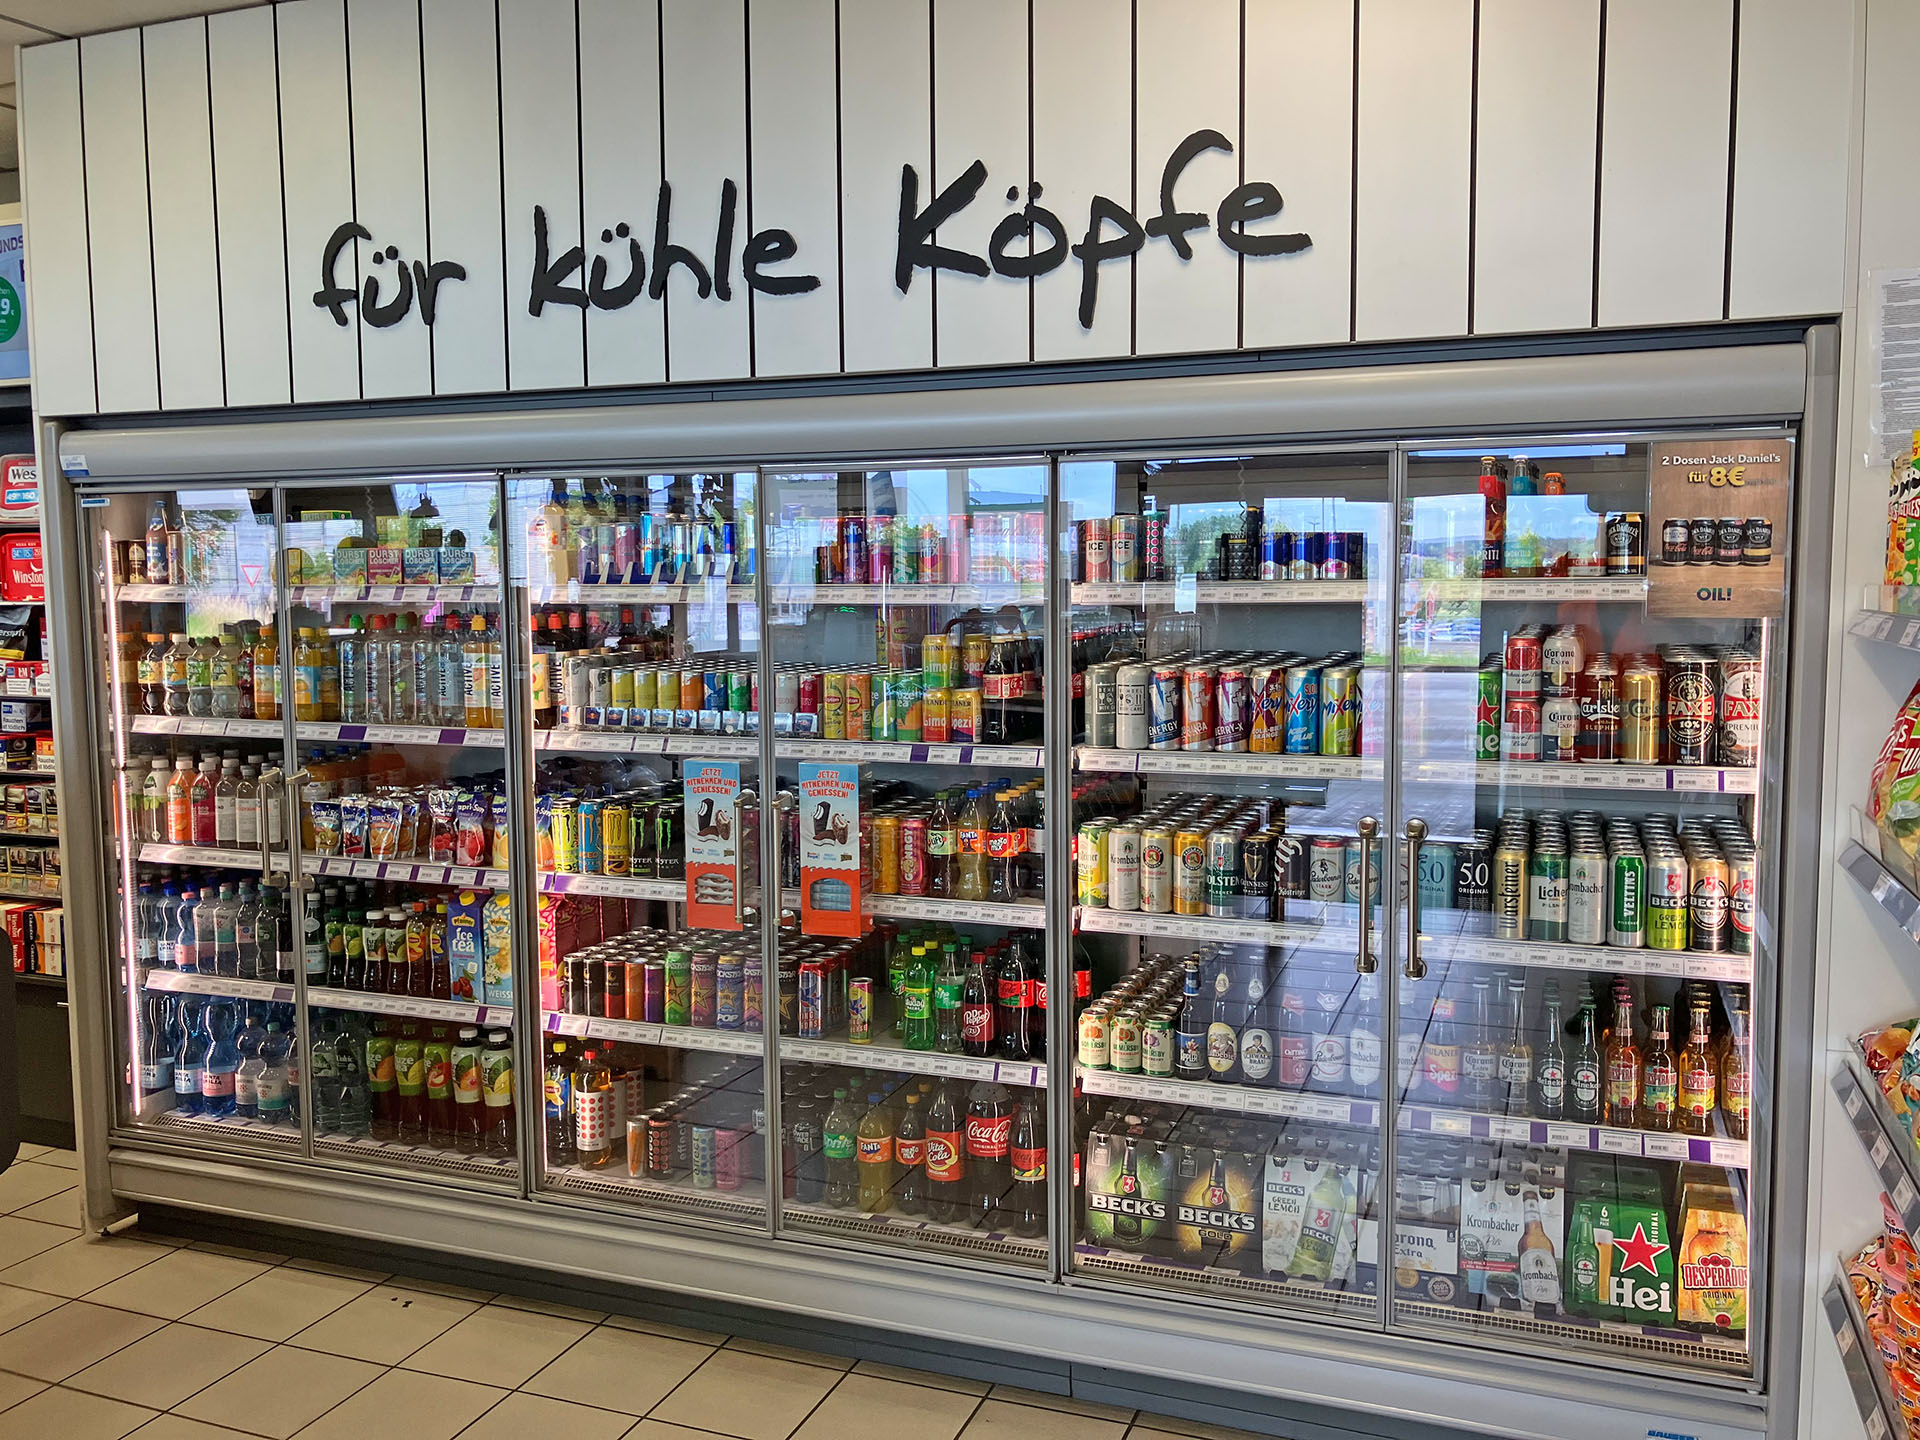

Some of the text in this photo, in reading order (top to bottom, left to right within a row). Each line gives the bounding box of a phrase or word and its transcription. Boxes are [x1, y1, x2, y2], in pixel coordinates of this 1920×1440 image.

[313, 129, 1313, 330] für kühle Köpfe
[1662, 453, 1781, 465] 2 Dosen Jack Daniel's
[1688, 471, 1708, 483] für
[1709, 466, 1746, 487] 8€
[1088, 541, 1104, 551] ICE
[1114, 540, 1130, 550] ICE
[369, 550, 399, 558] DURST
[404, 550, 434, 558] DURST
[442, 550, 472, 558] DURST
[13, 569, 44, 583] Winston
[1697, 587, 1732, 601] OIL!
[464, 662, 473, 696] ACTIVE
[491, 664, 501, 697] ACTIVE
[550, 661, 563, 694] ACTIVE
[1667, 701, 1713, 716] FAXE
[1149, 720, 1178, 736] ENERGY
[701, 768, 722, 777] JETZT
[816, 770, 839, 780] JETZT
[686, 777, 738, 787] MITNEHMEN UND
[801, 780, 856, 791] MITNEHMEN UND
[692, 786, 731, 795] GENIESSEN!
[807, 789, 849, 799] GENIESSEN!
[960, 831, 977, 841] FANTA
[1459, 861, 1489, 888] 5,0
[1458, 887, 1489, 895] ORIGINAL
[1499, 862, 1520, 930] Warsteiner
[1623, 871, 1636, 918] VELTINS
[456, 927, 473, 941] ice
[452, 939, 475, 953] tea
[717, 1014, 738, 1022] POP
[860, 1142, 881, 1151] FANTA
[928, 1142, 946, 1153] Vita
[928, 1151, 950, 1162] Cola
[1267, 1183, 1304, 1196] BECK'S
[1092, 1193, 1166, 1218] BECK'S
[1267, 1203, 1301, 1214] LEMON
[1601, 1206, 1608, 1218] 6
[1178, 1206, 1256, 1231] BECK'S
[1467, 1214, 1520, 1232] Krombacher
[1198, 1229, 1233, 1241] GOLD
[1650, 1212, 1659, 1248] ORIGINAL
[1610, 1276, 1672, 1313] Hei
[1703, 1291, 1736, 1300] ORIGINAL
